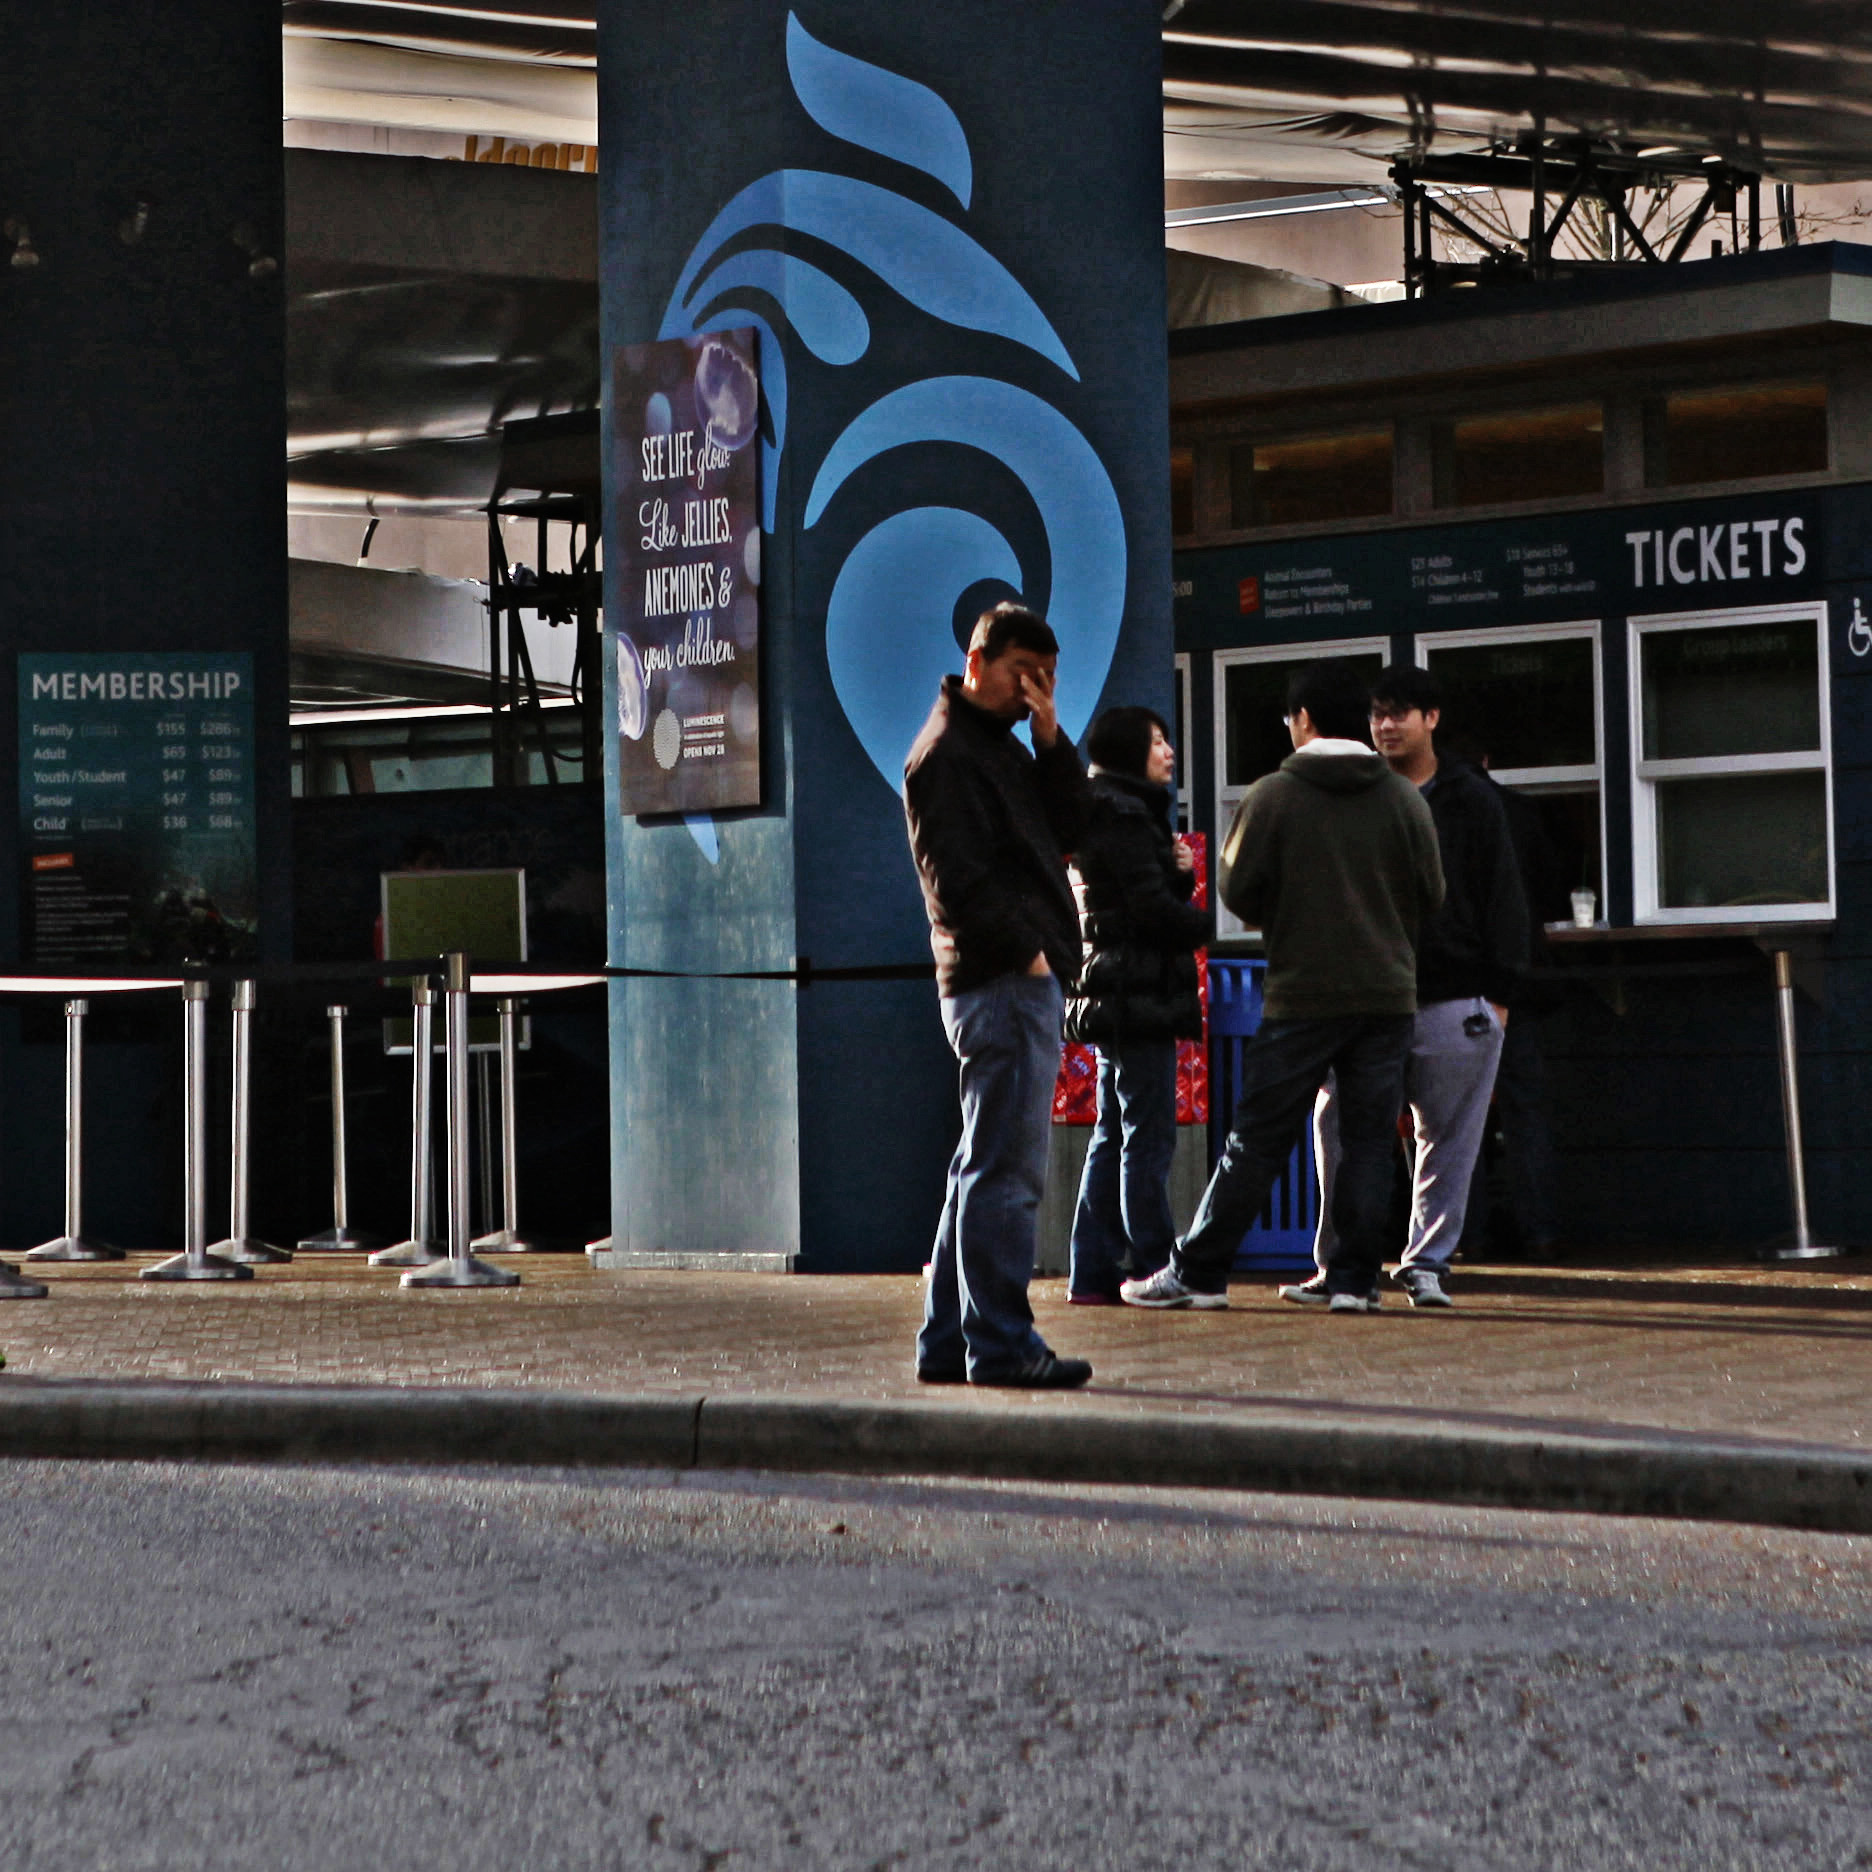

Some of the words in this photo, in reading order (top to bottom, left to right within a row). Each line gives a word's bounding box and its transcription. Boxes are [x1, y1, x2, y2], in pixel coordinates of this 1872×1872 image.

[641, 435, 665, 482] SEE
[668, 430, 695, 479] LIFE
[638, 498, 678, 552] Like
[1626, 517, 1806, 588] TICKETS
[644, 561, 715, 617] ANEMONES
[717, 566, 733, 608] &
[32, 671, 241, 700] MEMBERSHIP
[643, 645, 674, 690] your
[32, 722, 74, 740] Family
[33, 747, 67, 760] Adult
[33, 793, 73, 808] Senior
